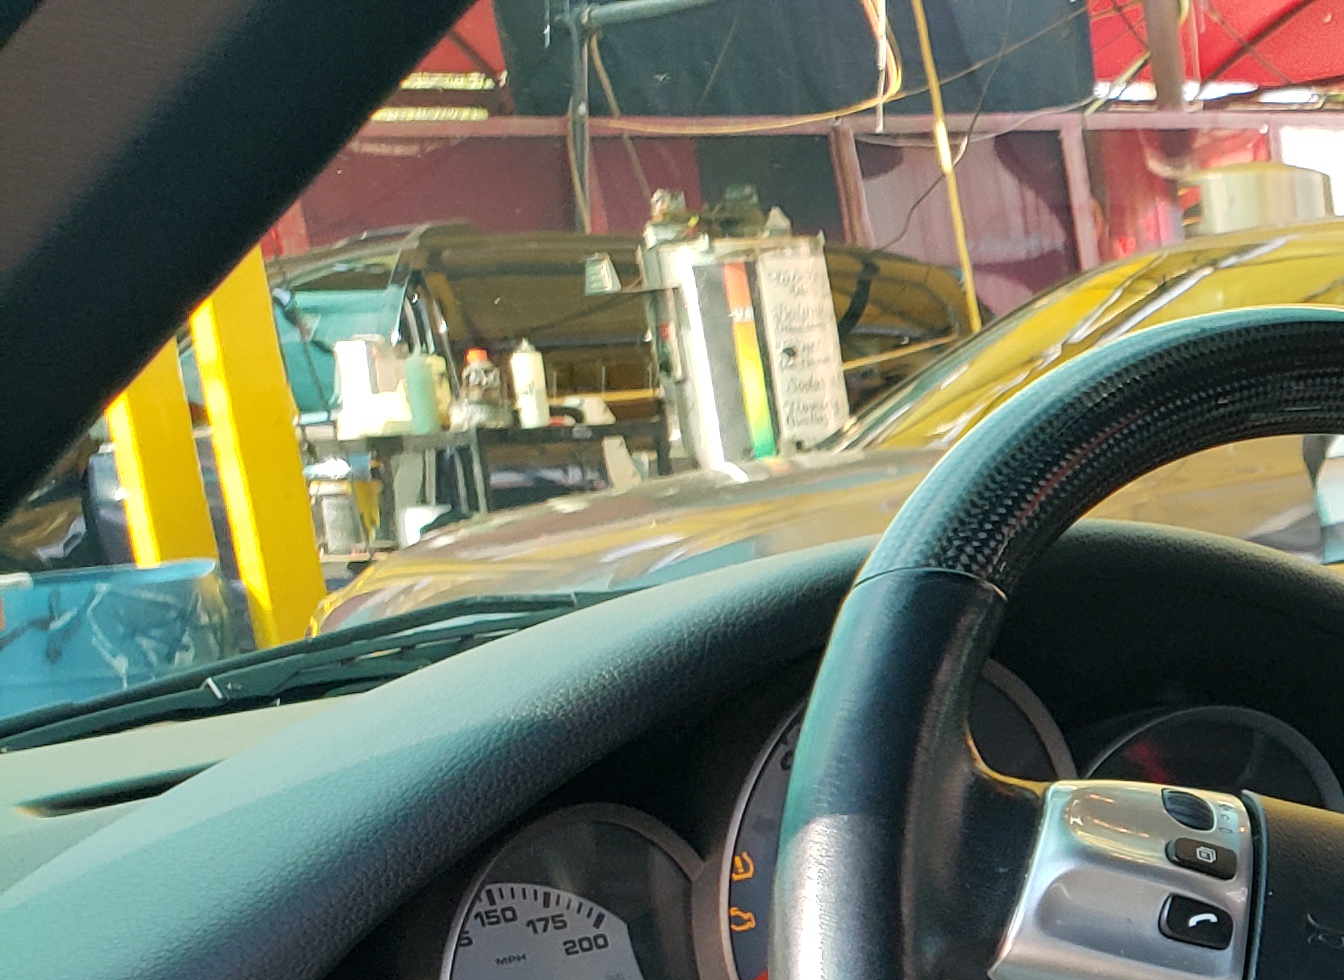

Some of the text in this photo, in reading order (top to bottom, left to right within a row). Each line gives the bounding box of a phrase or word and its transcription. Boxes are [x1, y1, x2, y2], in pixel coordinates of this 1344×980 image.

[474, 906, 518, 928] 150
[525, 913, 568, 935] 175
[563, 933, 609, 956] 200
[495, 954, 527, 967] MPH
